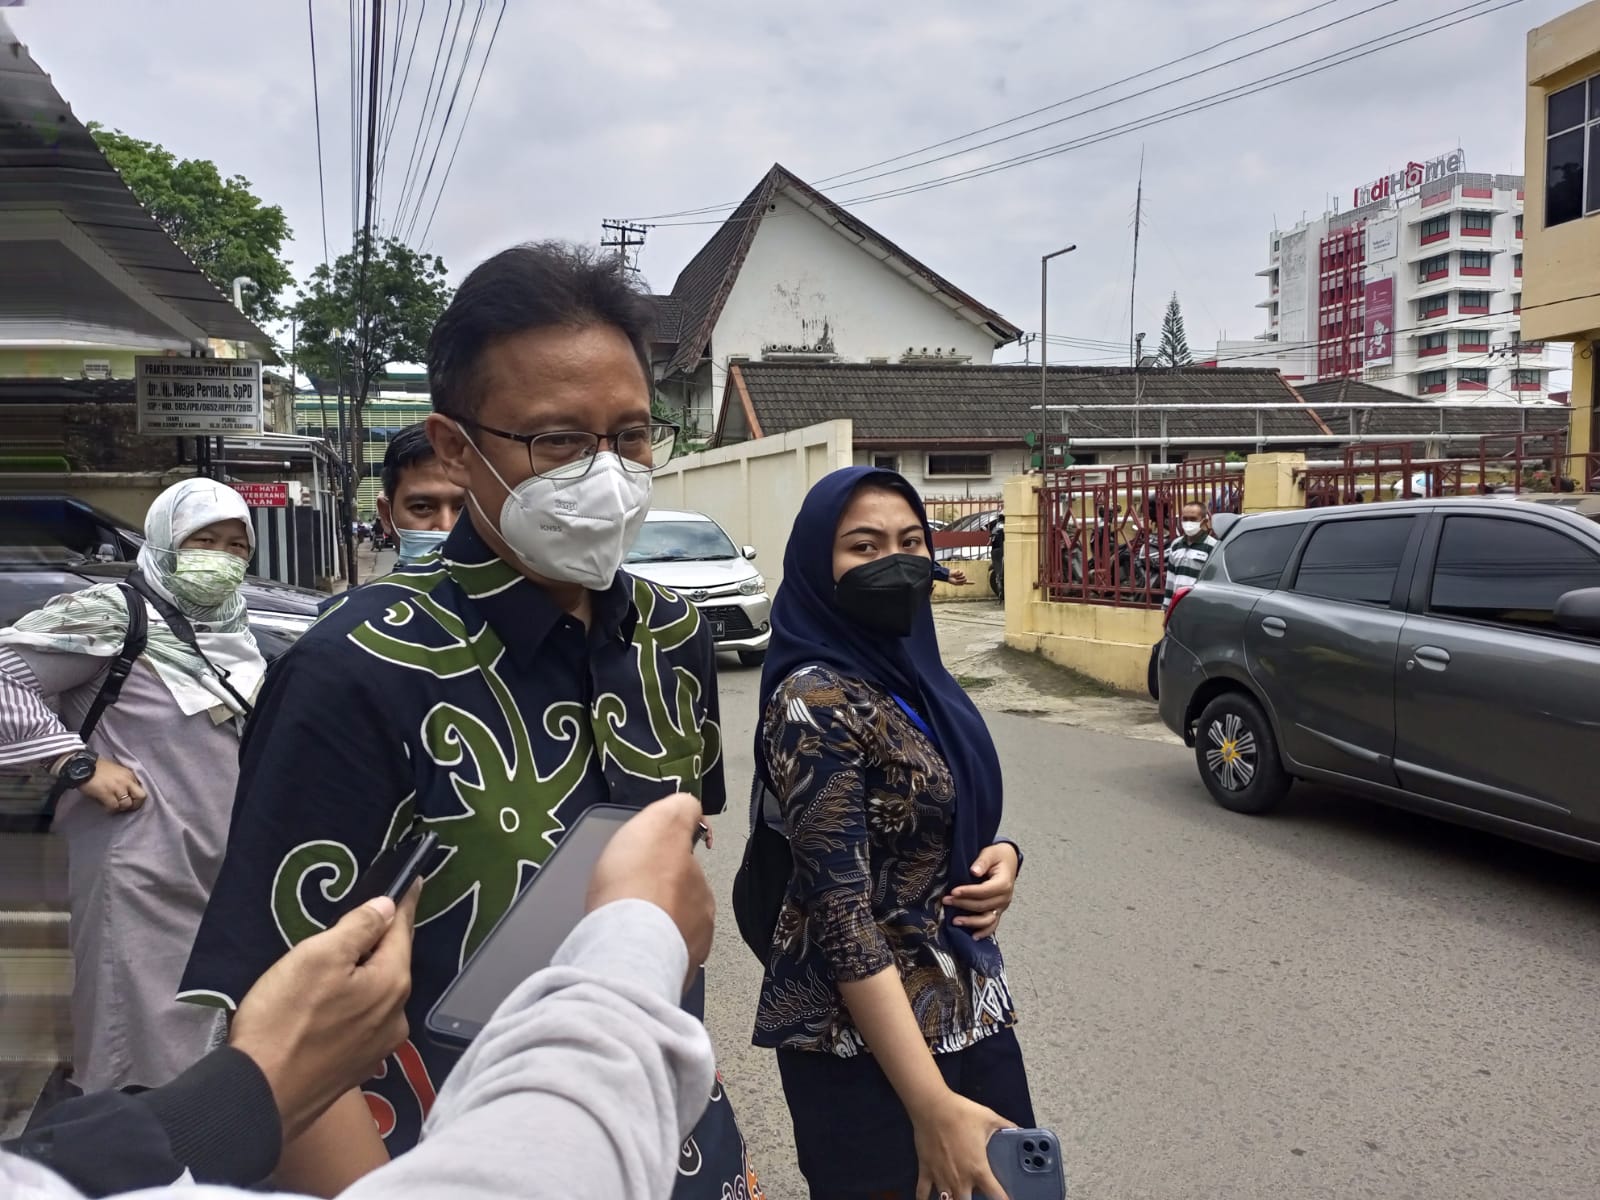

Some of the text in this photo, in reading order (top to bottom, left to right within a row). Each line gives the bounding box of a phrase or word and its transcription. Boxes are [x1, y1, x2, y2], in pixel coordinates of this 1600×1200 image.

[1354, 153, 1459, 208] IndiHome
[204, 365, 231, 377] PENYAKIT
[232, 366, 252, 377] DALAM
[233, 383, 252, 400] SpPD
